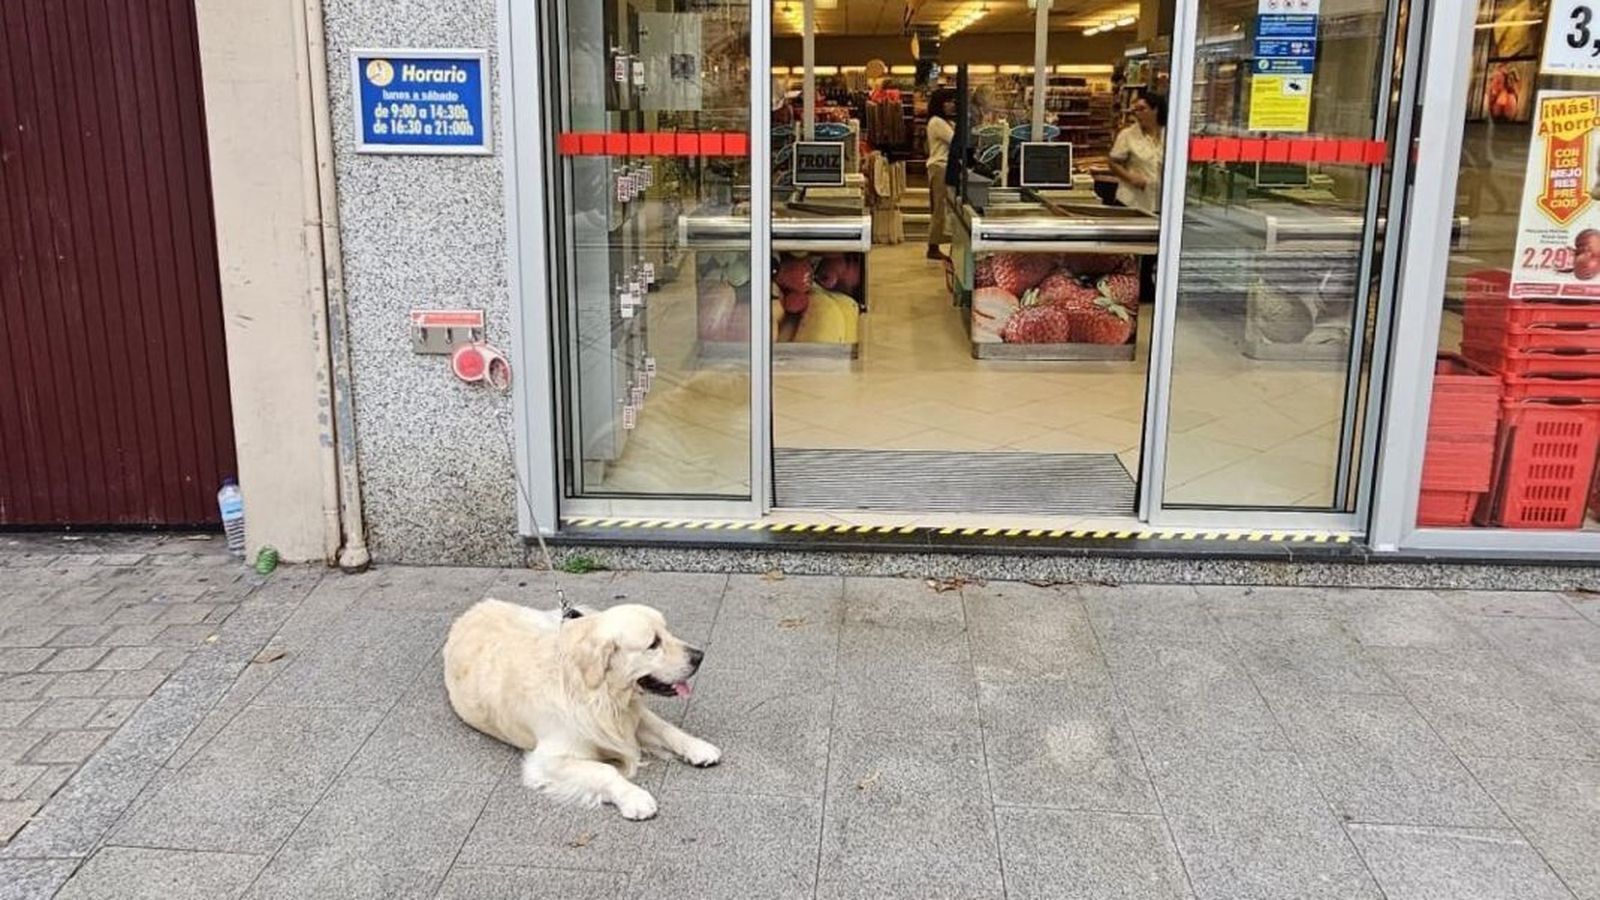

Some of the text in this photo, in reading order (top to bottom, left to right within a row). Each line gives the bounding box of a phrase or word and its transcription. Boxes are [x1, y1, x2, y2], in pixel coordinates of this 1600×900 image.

[402, 64, 467, 83] Horario
[383, 89, 459, 102] lunes a sábado
[374, 102, 469, 120] de 9:00 a 14:30h
[373, 119, 474, 136] de 16:30 a 21:00h
[798, 154, 841, 169] FROIZ
[1555, 149, 1579, 158] CON
[1555, 158, 1579, 168] LOS
[1522, 246, 1568, 270] 2,29
